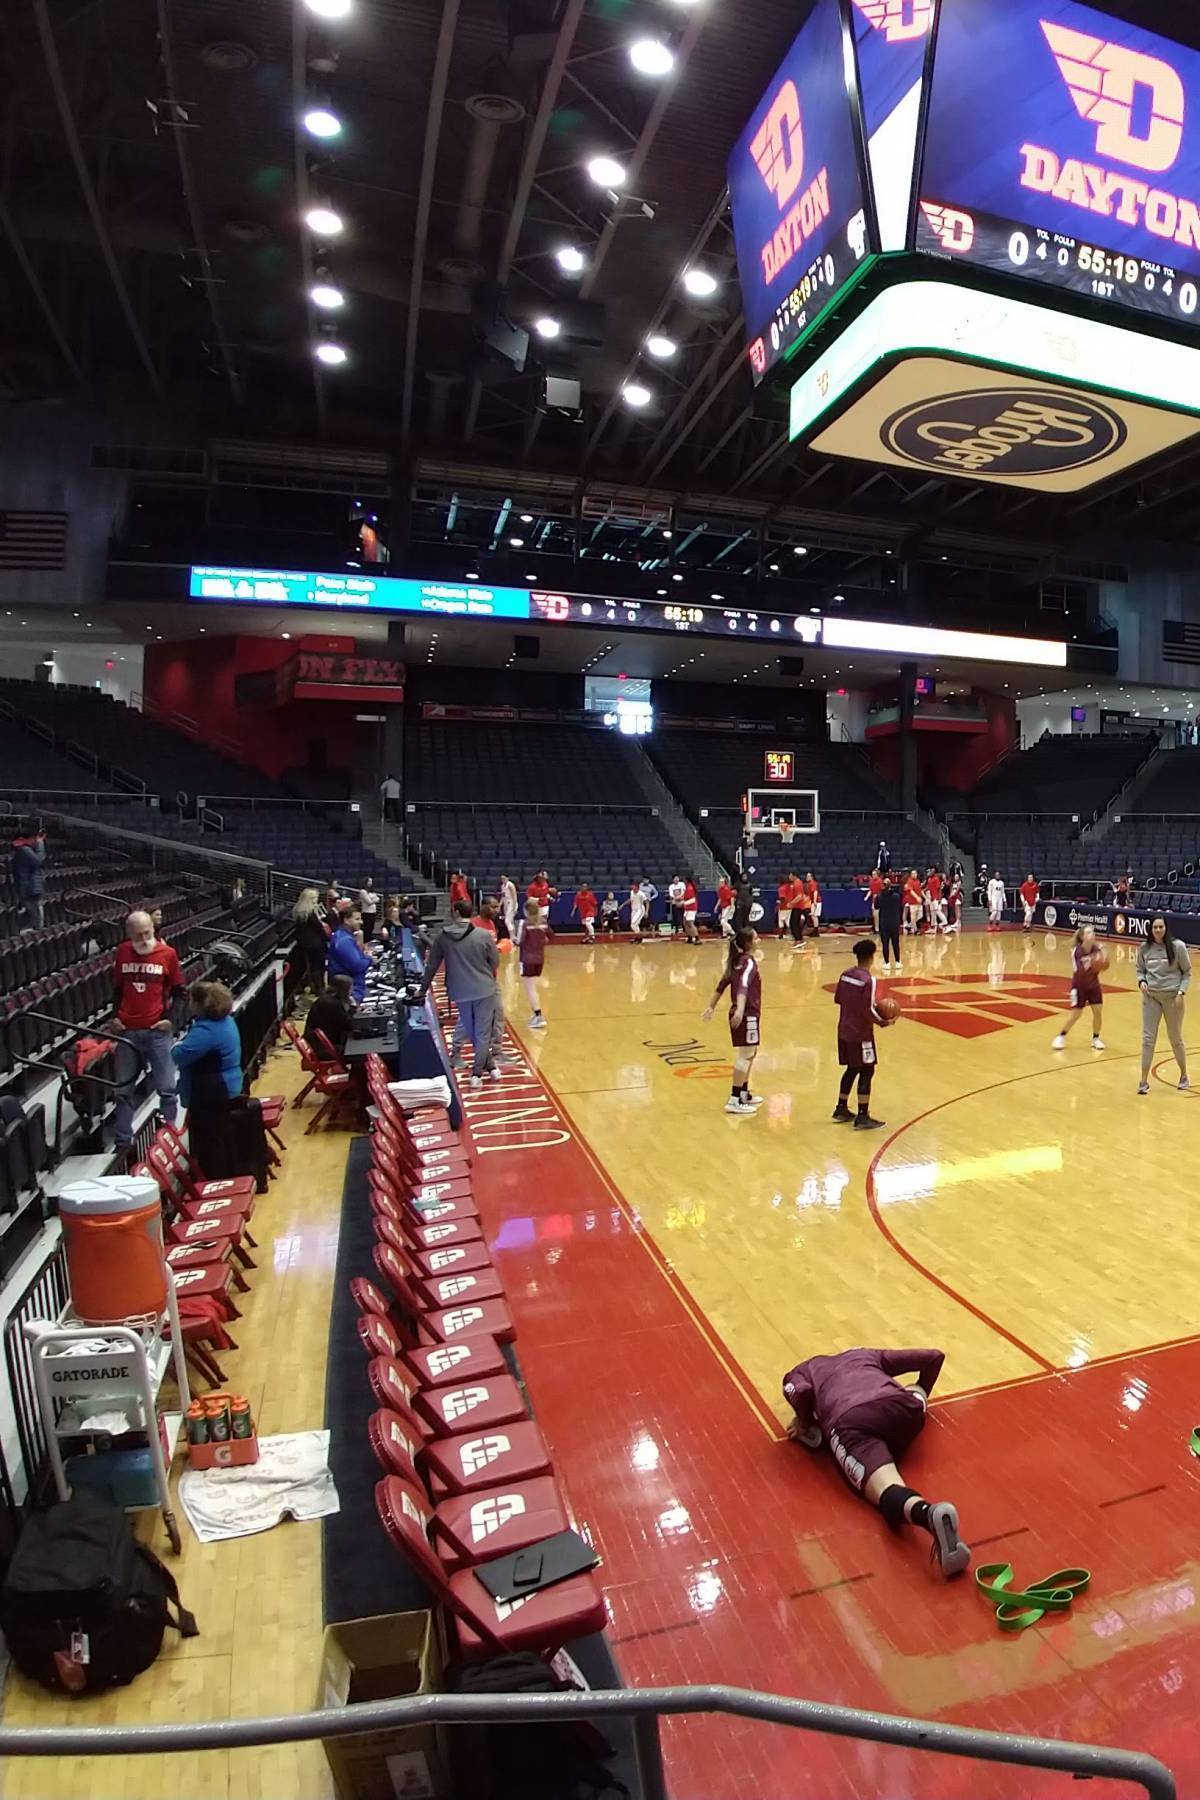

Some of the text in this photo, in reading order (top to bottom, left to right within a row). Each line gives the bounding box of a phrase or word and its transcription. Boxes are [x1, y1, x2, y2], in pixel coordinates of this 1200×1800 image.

[761, 166, 831, 285] DAYTON
[1009, 231, 1198, 314] 0 4 0 55:19 0 4 0
[789, 275, 811, 316] 55:19
[917, 401, 1095, 470] Kroger
[664, 605, 703, 623] 55:19
[770, 763, 787, 778] 30
[121, 962, 163, 975] DAYTON
[52, 1366, 130, 1383] GATORADE
